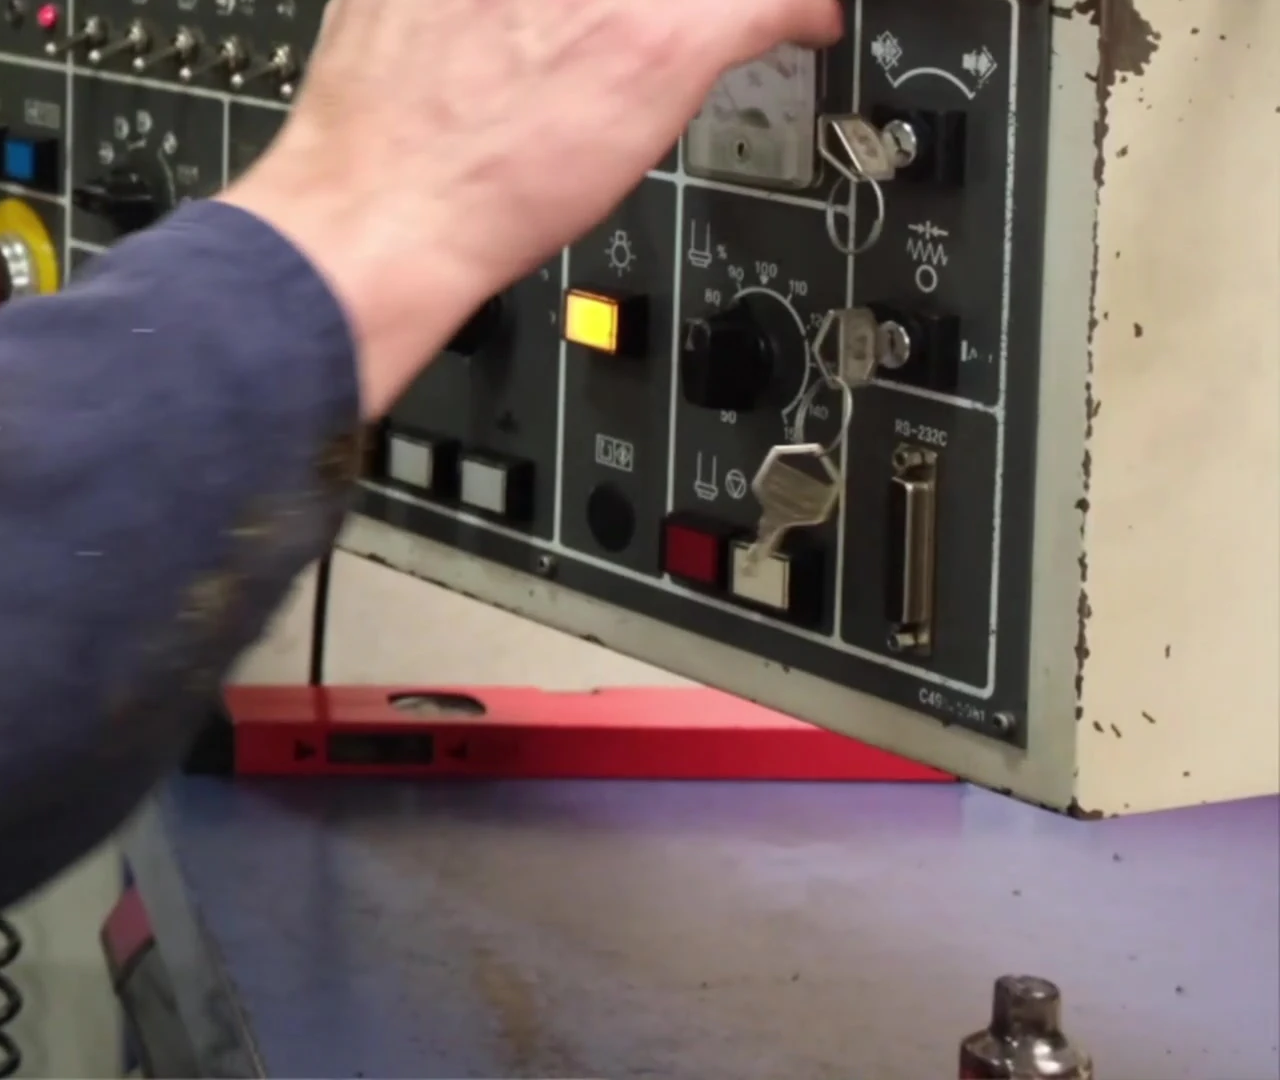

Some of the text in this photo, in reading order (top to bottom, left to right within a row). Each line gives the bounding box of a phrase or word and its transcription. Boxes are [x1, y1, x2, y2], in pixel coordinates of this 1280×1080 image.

[704, 288, 721, 307] 80
[727, 264, 745, 281] 90
[754, 261, 778, 279] 100
[788, 280, 808, 297] 110
[894, 418, 948, 447] RS-232C
